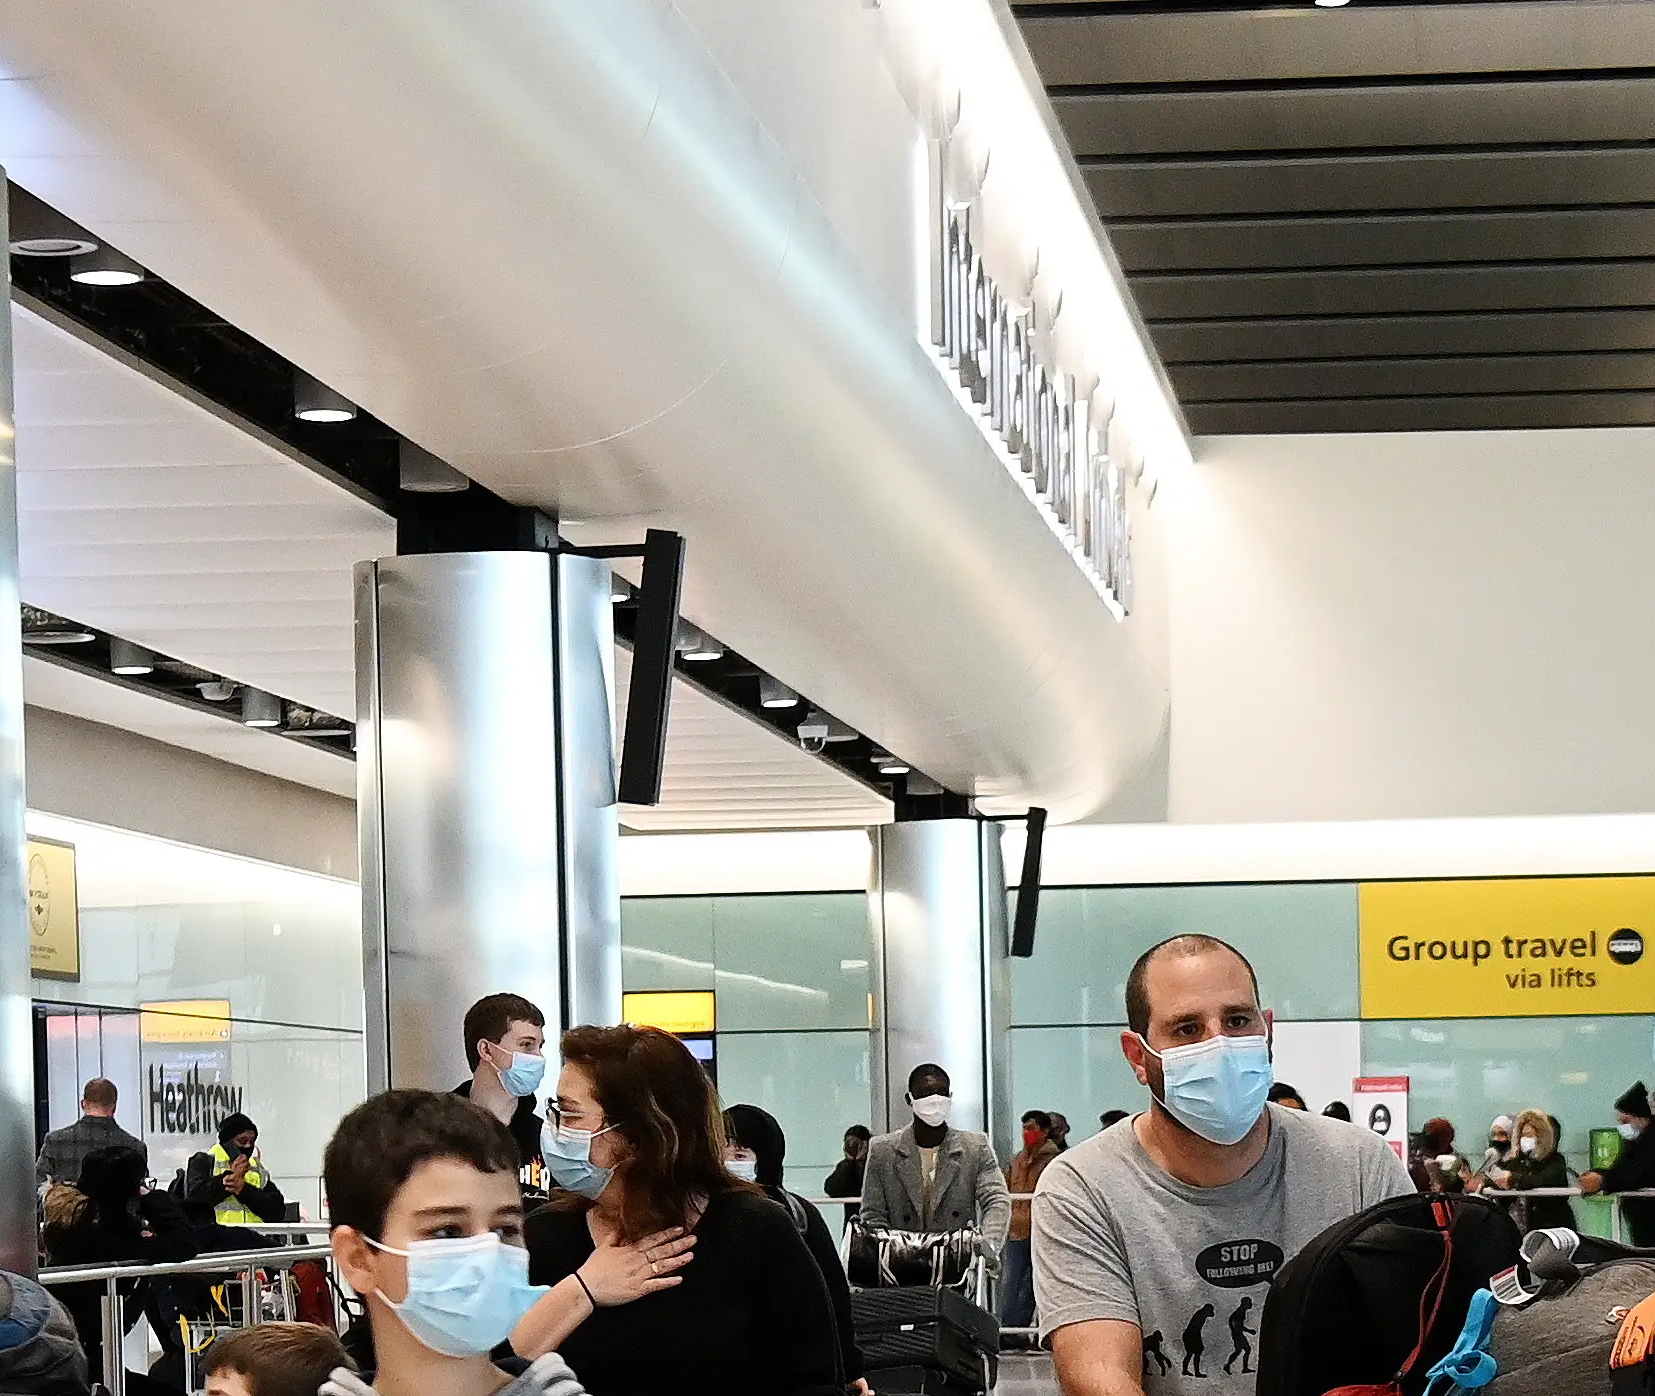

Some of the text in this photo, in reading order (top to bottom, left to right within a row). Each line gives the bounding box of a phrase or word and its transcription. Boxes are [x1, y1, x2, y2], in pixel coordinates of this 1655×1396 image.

[1386, 930, 1597, 967] Group travel
[1504, 966, 1597, 989] via lifts
[148, 1060, 243, 1135] Heathrow
[1221, 1244, 1258, 1262] STOP
[1207, 1261, 1273, 1278] FOLLOWING ME!
